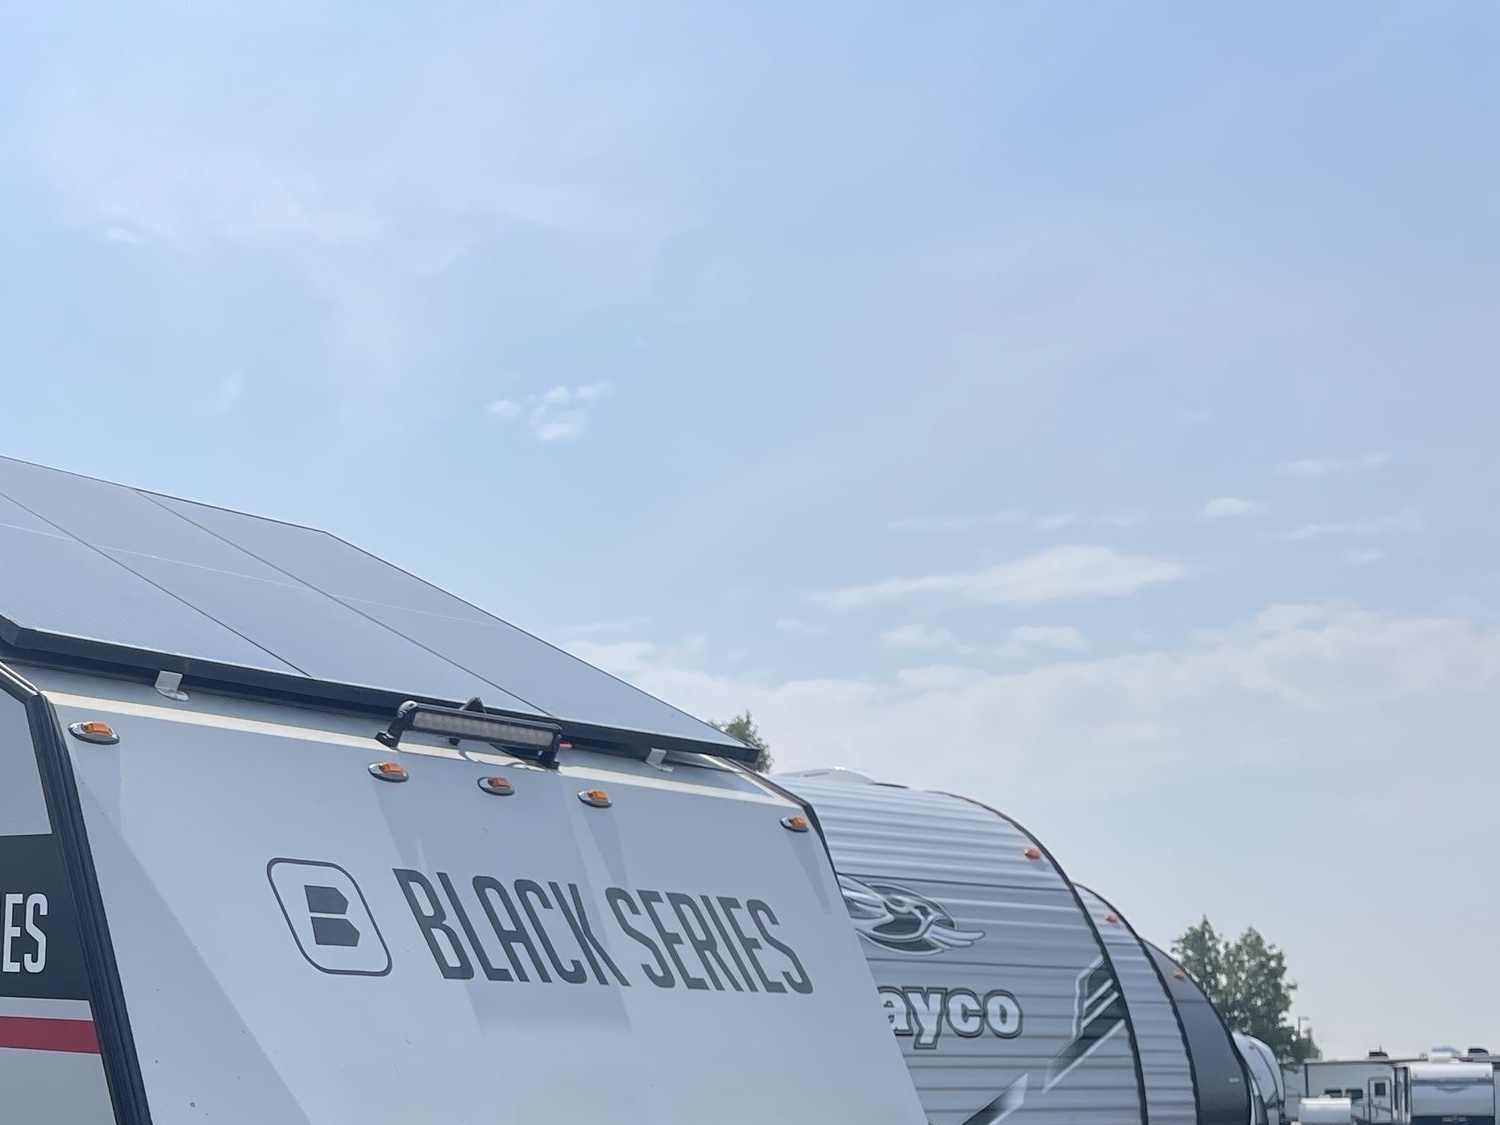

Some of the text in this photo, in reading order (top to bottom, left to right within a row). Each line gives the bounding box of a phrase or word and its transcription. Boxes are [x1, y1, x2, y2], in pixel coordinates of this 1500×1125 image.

[392, 868, 632, 986] BLACK
[605, 887, 814, 994] SERIES
[877, 986, 1024, 1050] ayco
